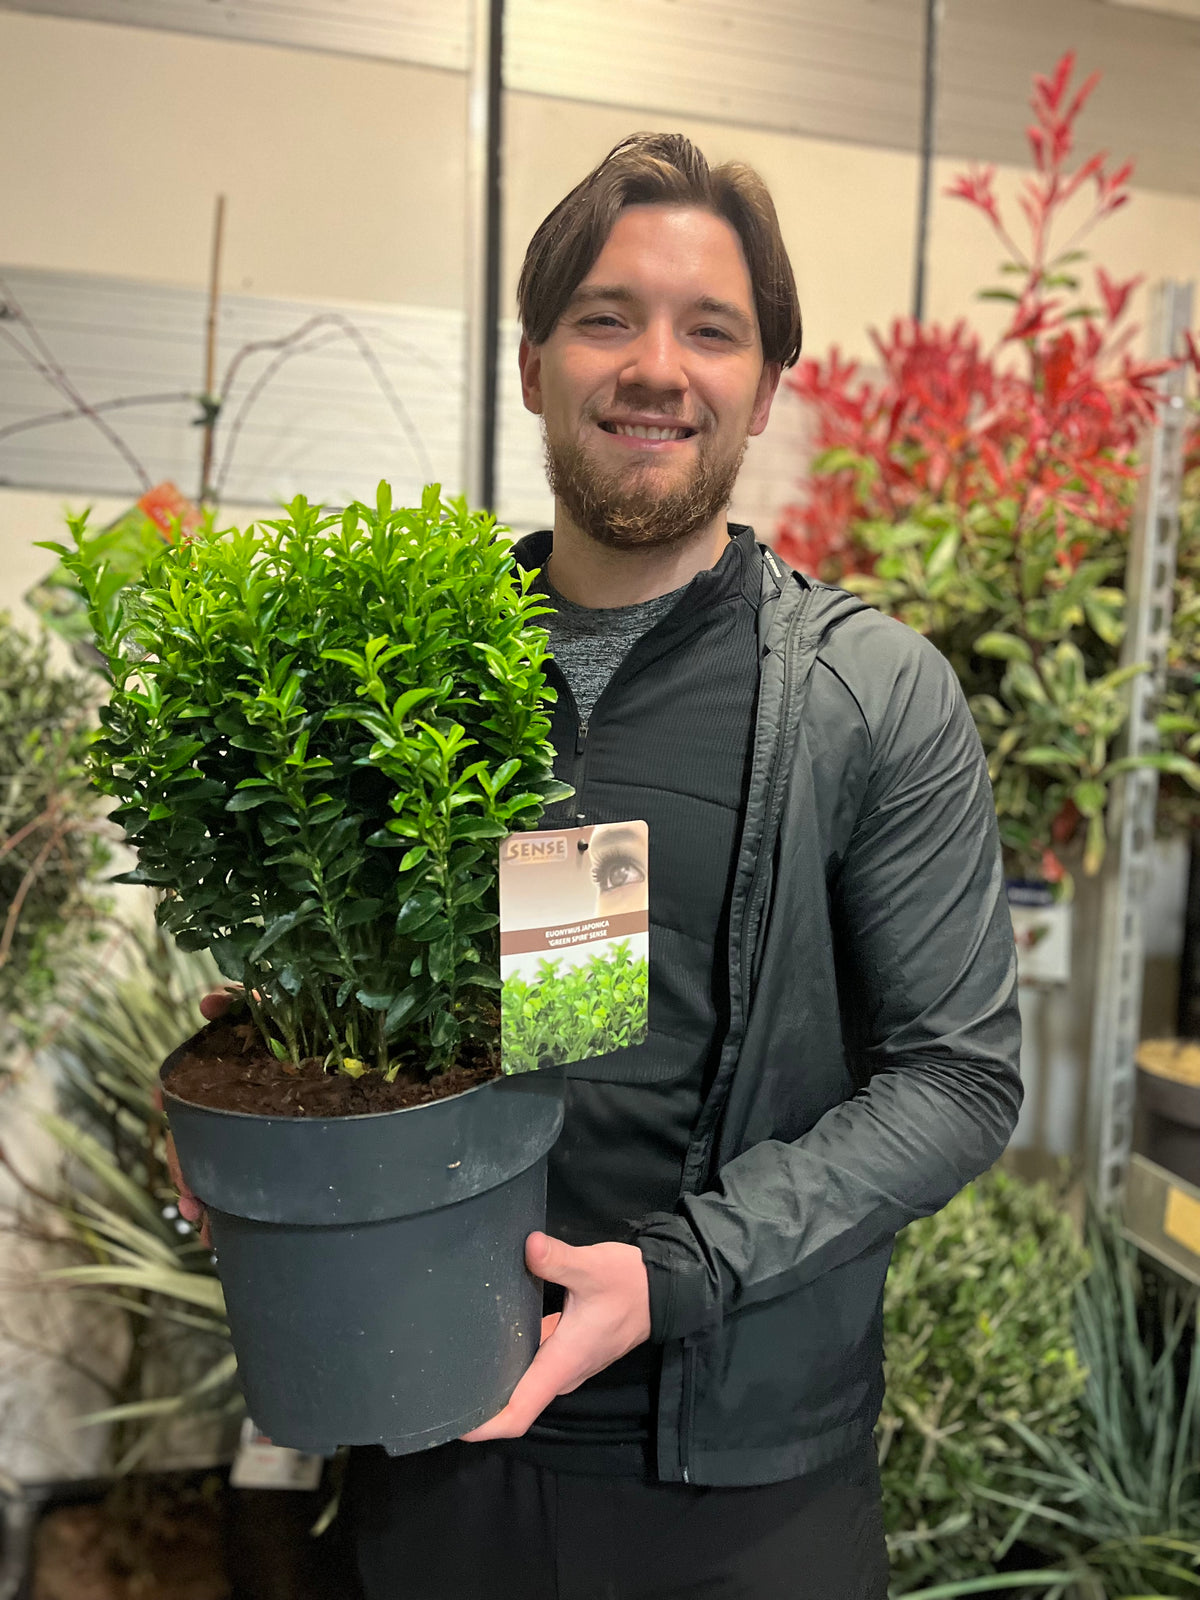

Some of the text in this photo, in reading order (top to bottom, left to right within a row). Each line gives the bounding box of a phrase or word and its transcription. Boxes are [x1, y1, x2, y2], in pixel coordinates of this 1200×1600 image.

[502, 841, 565, 860] SENSE
[545, 920, 610, 938] EUONYMUS JAPONICA
[589, 929, 608, 939] SENSE
